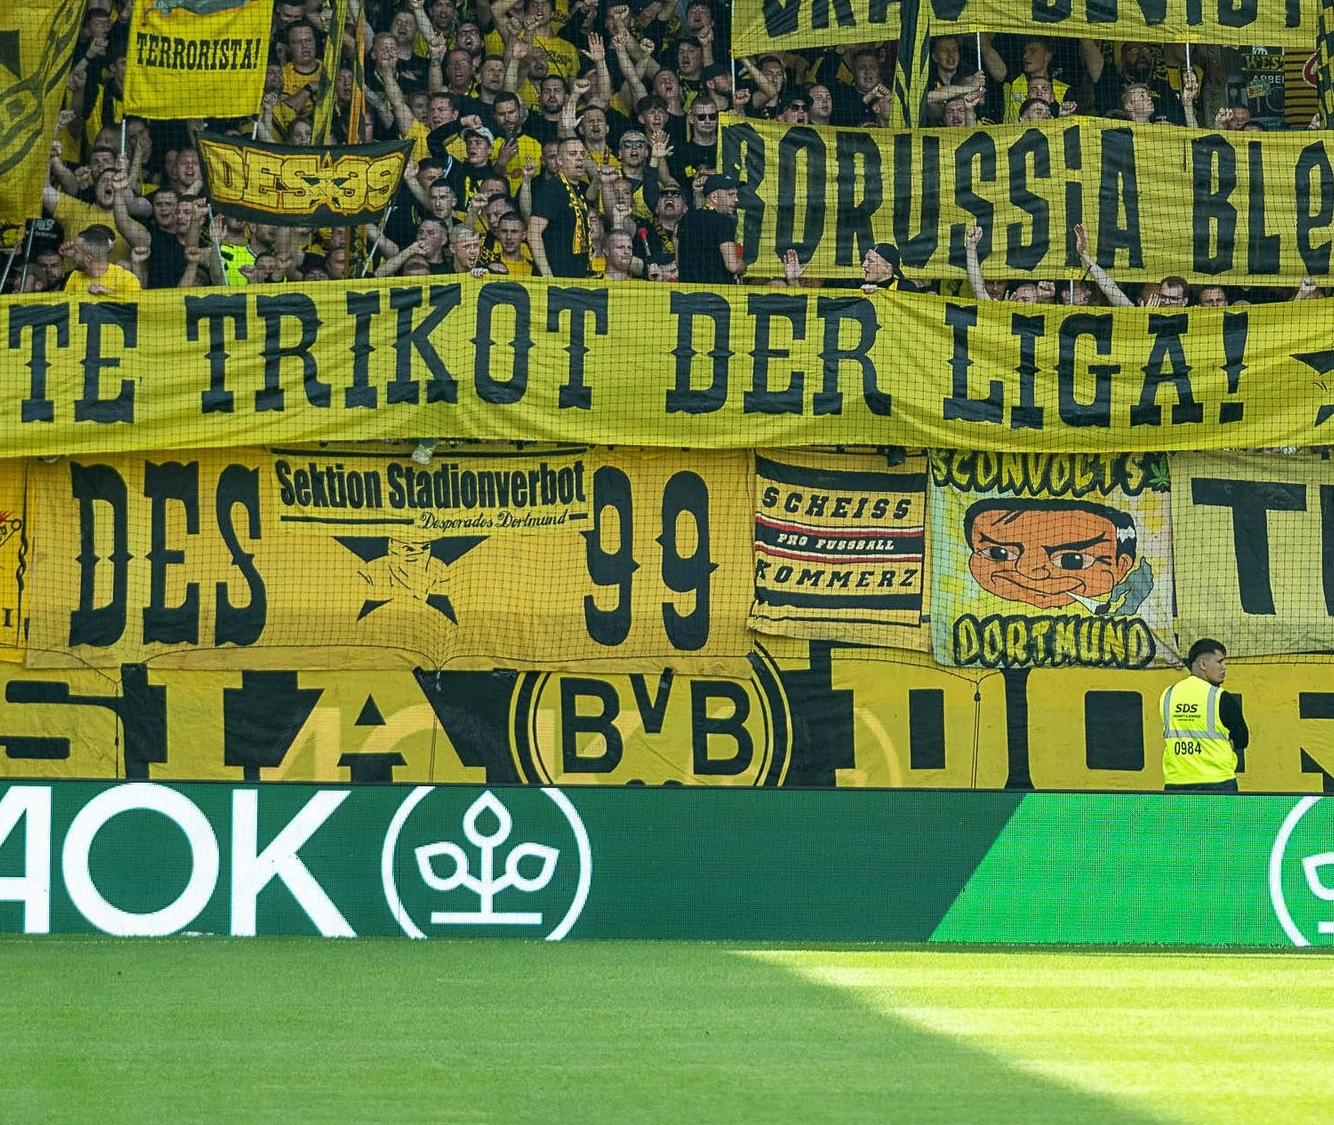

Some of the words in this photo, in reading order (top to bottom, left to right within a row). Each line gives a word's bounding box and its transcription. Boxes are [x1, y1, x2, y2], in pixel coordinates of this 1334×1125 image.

[137, 32, 262, 72] TERRORISTA!
[186, 282, 608, 415] TRIKOT
[666, 292, 891, 417] DER
[943, 303, 1246, 429] LIGA!
[275, 459, 383, 509] Sektion
[386, 459, 586, 510] Stadionverbot
[762, 487, 912, 520] SCHEISS
[69, 462, 267, 648] DES
[587, 464, 718, 652] 99
[755, 558, 918, 588] KOMMERZ
[953, 613, 1156, 669] DORTMUND
[1175, 703, 1199, 713] SDS
[1174, 741, 1202, 755] 0984
